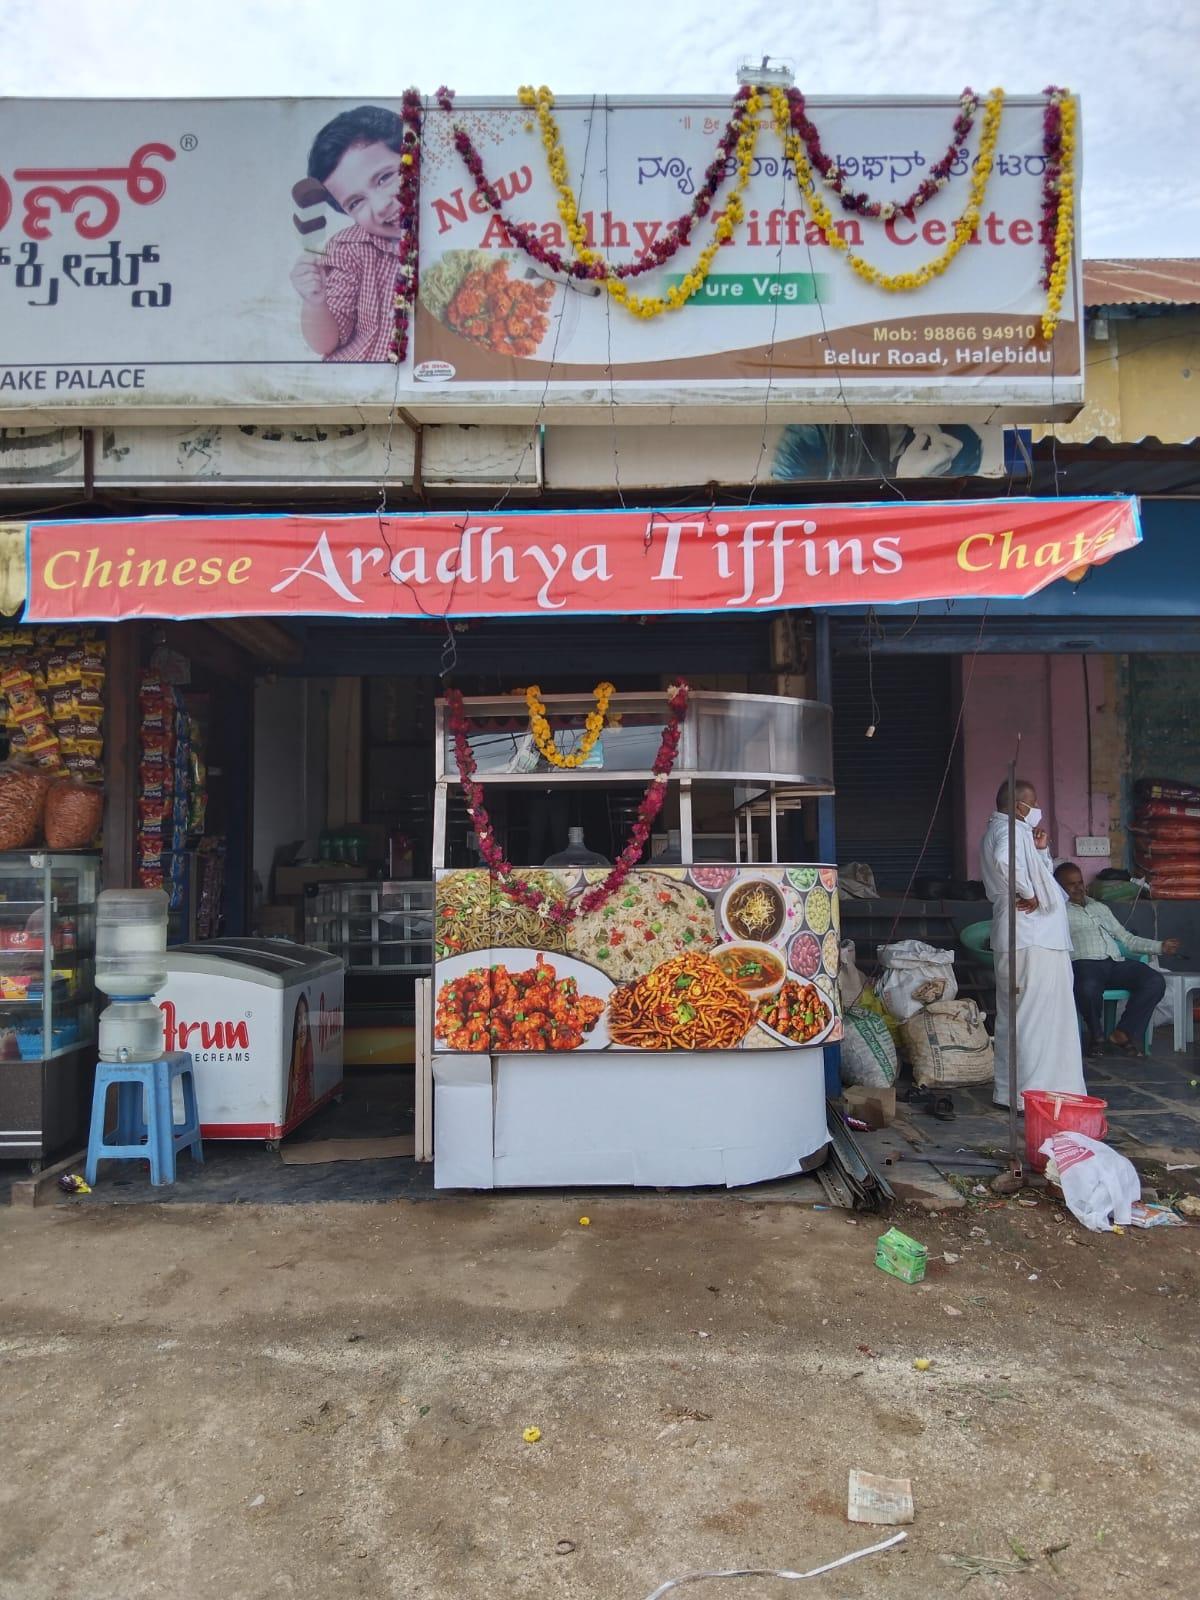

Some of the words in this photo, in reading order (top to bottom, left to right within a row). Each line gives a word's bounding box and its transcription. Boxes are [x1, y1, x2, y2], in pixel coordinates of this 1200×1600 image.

[884, 206, 1047, 246] Cete
[752, 277, 798, 300] Veg
[873, 327, 917, 342] Mob:
[924, 327, 977, 342] 98866
[982, 325, 1036, 341] 94910
[824, 348, 880, 365] Belur
[887, 348, 949, 367] Road,
[956, 346, 1051, 364] Halebidu
[0, 370, 47, 391] AKE
[55, 369, 146, 390] PALACE
[43, 547, 252, 590] Chinese
[270, 526, 613, 608] Aradhya
[645, 519, 903, 606] Tiffins
[957, 527, 1117, 573] Chats
[194, 1052, 250, 1062] ECREAMS
